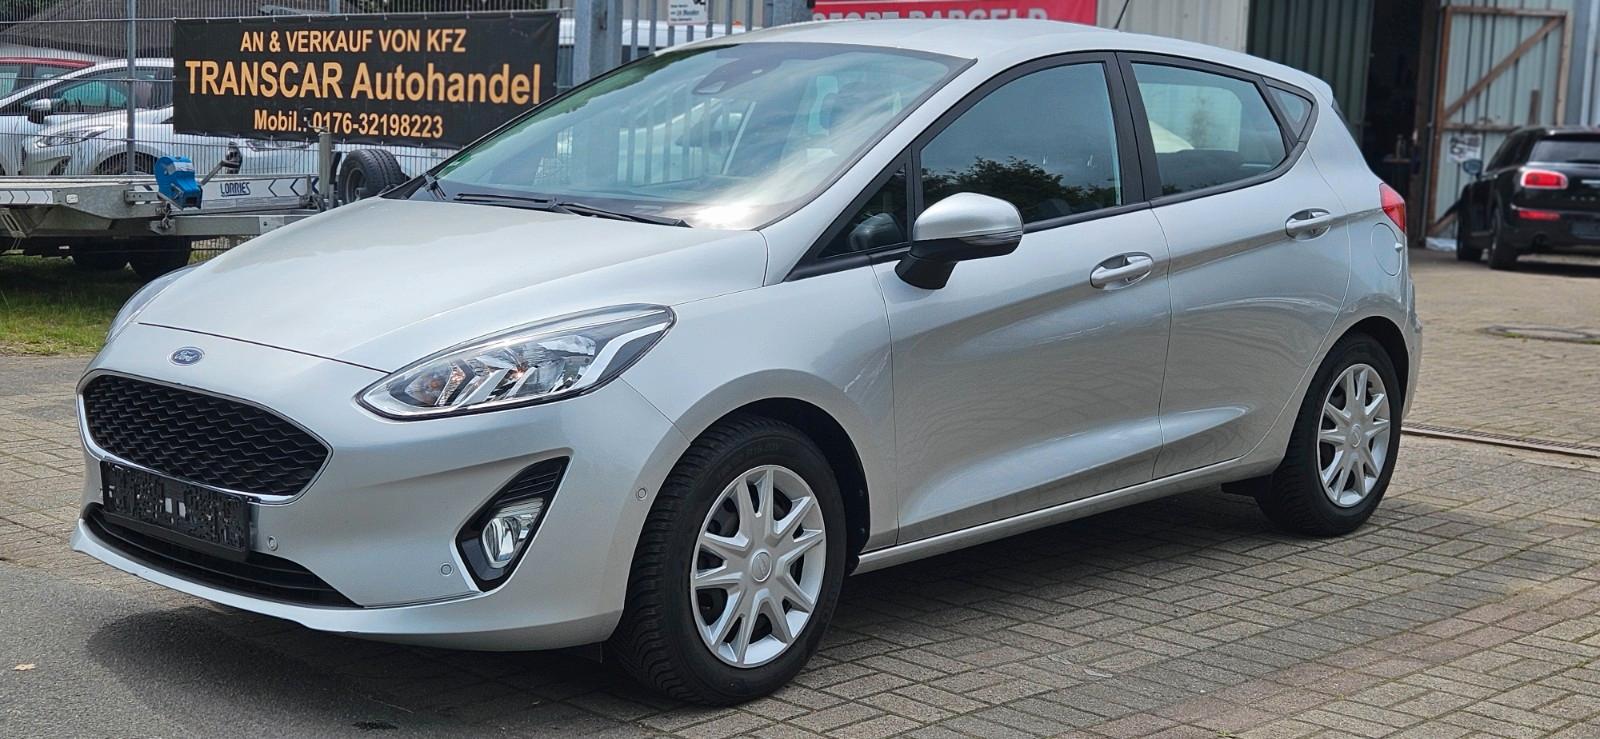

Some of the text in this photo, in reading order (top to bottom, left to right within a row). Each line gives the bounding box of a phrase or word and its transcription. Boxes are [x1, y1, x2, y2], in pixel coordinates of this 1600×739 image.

[240, 28, 467, 53] AN & VERKAUF VON KFZ
[184, 60, 541, 105] TRANSCAR Autohandel
[254, 109, 443, 138] Mobil.: 0176-32198223
[220, 182, 251, 197] LORRIES
[173, 349, 200, 363] Ford
